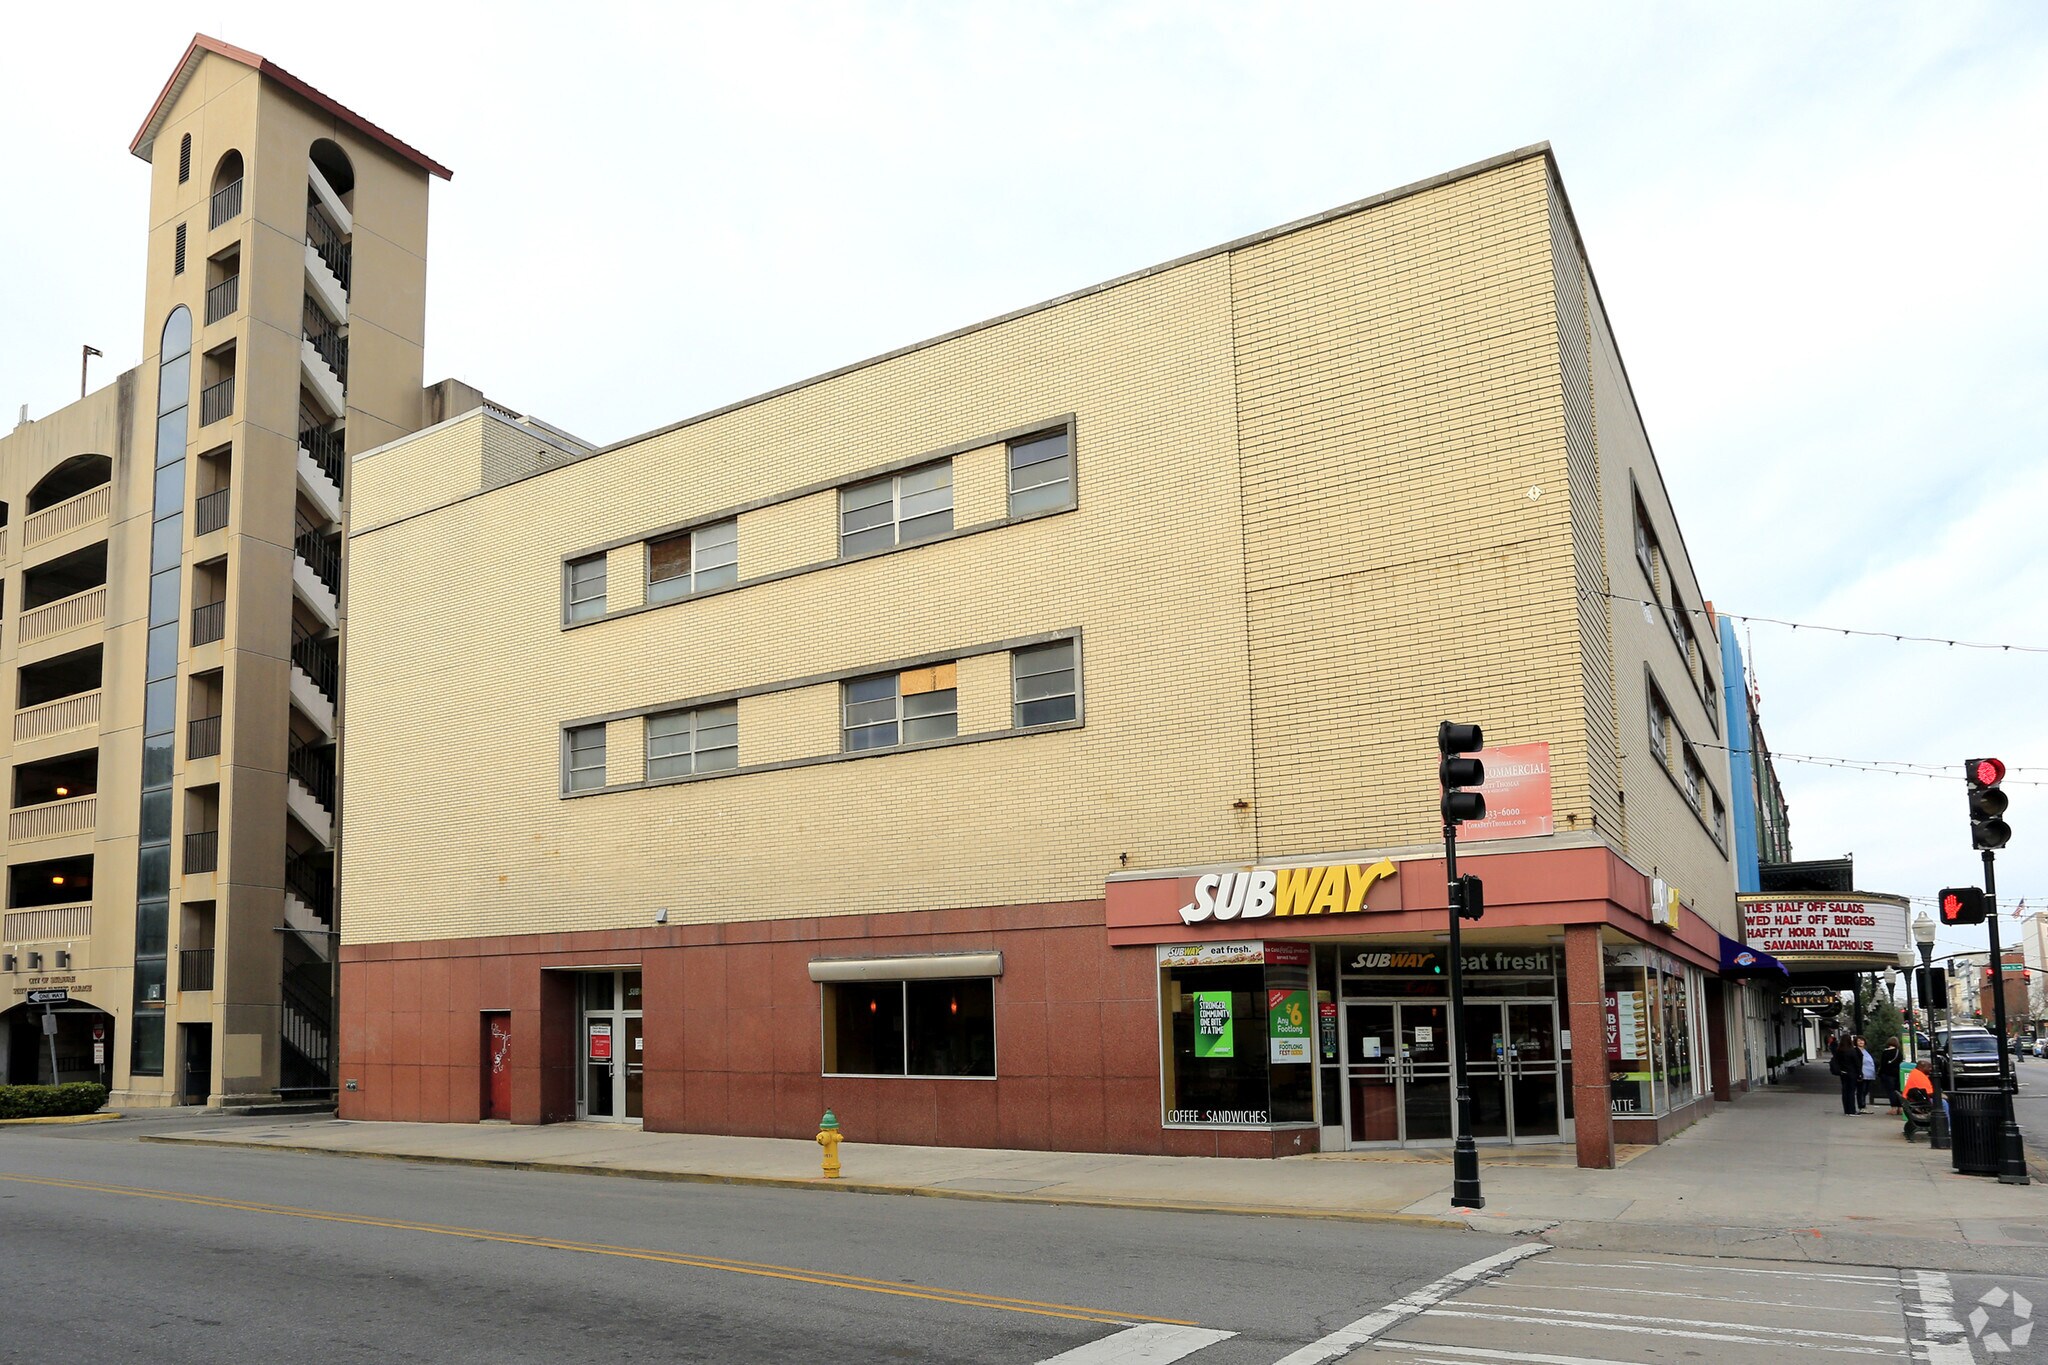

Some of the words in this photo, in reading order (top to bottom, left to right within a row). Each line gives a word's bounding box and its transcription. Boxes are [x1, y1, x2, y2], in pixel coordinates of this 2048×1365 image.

[1178, 857, 1398, 926] SUBWAY
[1745, 903, 1772, 914] TUES
[1776, 902, 1804, 913] HALF
[1807, 902, 1827, 912] OFF
[1829, 903, 1864, 913] SALADS
[1745, 916, 1770, 926] WED
[1775, 915, 1803, 925] HALF
[1808, 915, 1828, 925] OFF
[1834, 916, 1875, 926] BURGERS
[1788, 927, 1816, 938] HOUR
[1823, 927, 1850, 938] DAILY
[1168, 945, 1204, 957] SUBWAY
[1210, 947, 1225, 955] eat
[1764, 940, 1824, 950] SAVANNAH
[1827, 940, 1874, 951] TAPHOUSE
[1351, 953, 1436, 968] SUBWAY
[1460, 955, 1489, 970] eat
[1495, 952, 1548, 970] fresh
[1199, 1001, 1226, 1010] STRONGER
[1286, 1003, 1302, 1025] $6
[1200, 1018, 1210, 1026] ONE
[1277, 1017, 1289, 1026] Any
[1200, 1026, 1207, 1034] AT
[1207, 1026, 1212, 1034] A
[1212, 1026, 1224, 1034] TIME
[1278, 1025, 1303, 1034] Footlong
[1168, 1109, 1199, 1123] COFFEE
[1206, 1110, 1267, 1123] SANDWICHES
